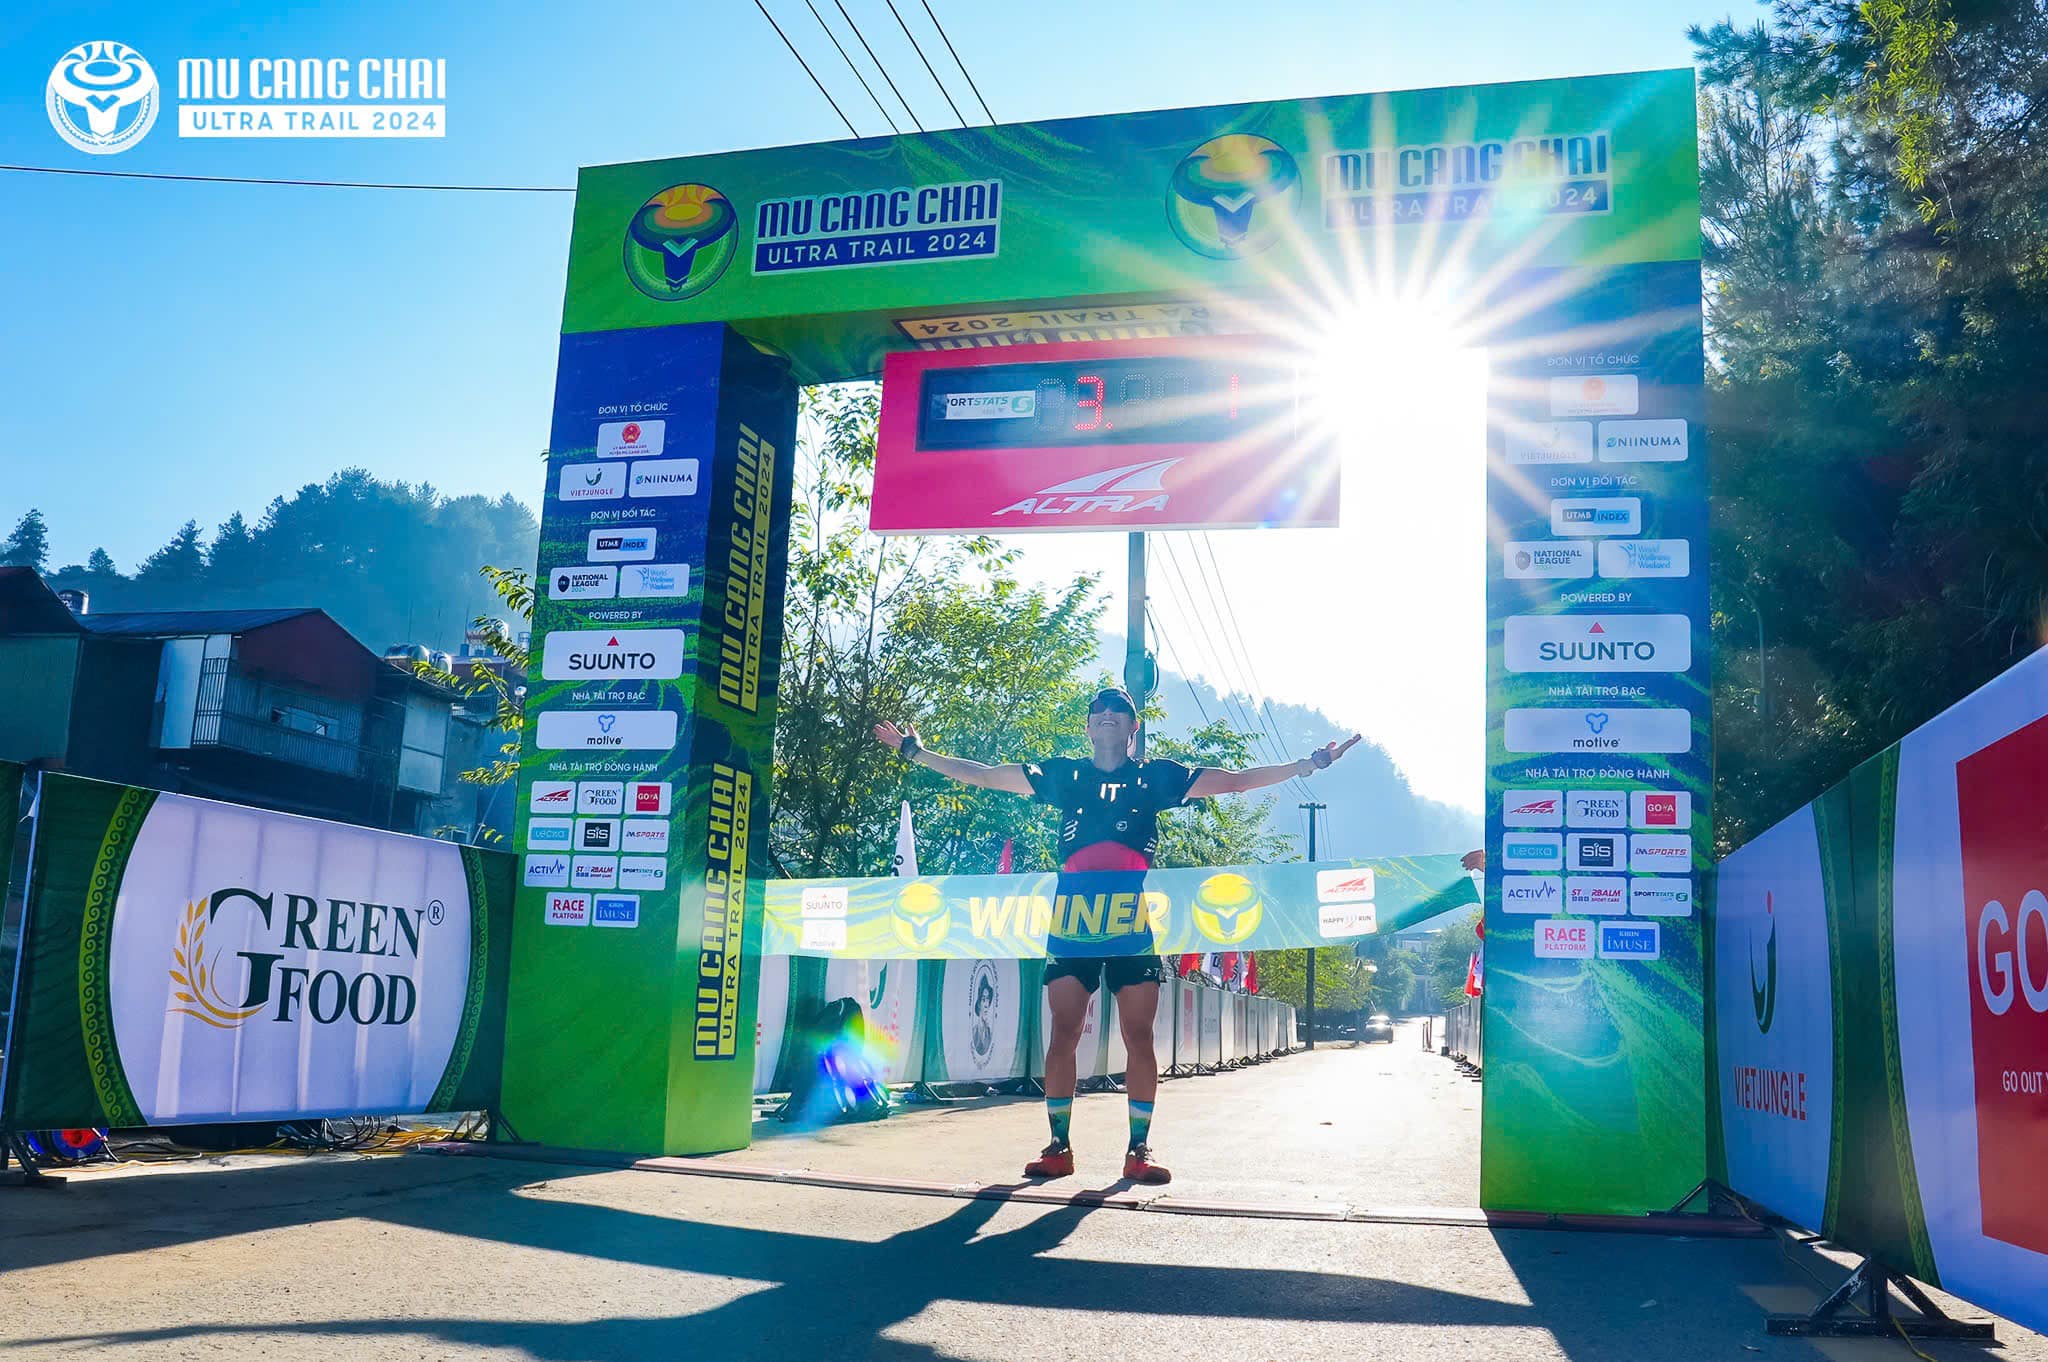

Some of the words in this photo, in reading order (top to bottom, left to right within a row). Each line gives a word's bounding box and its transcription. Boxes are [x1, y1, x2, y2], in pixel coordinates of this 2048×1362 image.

[1400, 142, 1503, 188] CANG
[1524, 184, 1599, 211] 024
[757, 199, 813, 239] MU
[819, 190, 910, 234] CANG
[916, 181, 998, 226] CHAI
[767, 244, 839, 266] ULTRA
[848, 238, 916, 259] TRAIL
[926, 231, 987, 253] 2024
[945, 394, 1009, 408] ORTSTATS
[1617, 436, 1681, 447] NIINUMA
[644, 474, 693, 484] NIINUMA
[734, 422, 759, 520] CHAI
[758, 446, 771, 516] 2024
[570, 487, 614, 497] VIETJUNGLE
[992, 495, 1172, 516] ALTRA
[1566, 510, 1592, 521] UTMB
[1598, 511, 1628, 522] INDEX
[1533, 549, 1582, 558] NATIONAL
[1533, 557, 1572, 565] LEAGUE
[751, 529, 767, 601] TRAIL
[725, 521, 752, 631] CANG
[1561, 593, 1616, 602] POWERED
[1618, 593, 1632, 602] BY
[588, 611, 630, 620] POWERED
[632, 611, 642, 619] BY
[568, 652, 656, 671] SUUNTO
[745, 614, 760, 696] ULTRA
[1539, 641, 1656, 661] SUUNTO
[719, 632, 743, 705] MU
[594, 797, 617, 806] FOOD
[708, 762, 735, 861] CHAI
[735, 781, 749, 850] 2024
[1590, 809, 1619, 818] FOOD
[1582, 842, 1611, 858] SiS
[553, 898, 584, 912] RACE
[728, 863, 744, 941] TRAIL
[806, 900, 843, 910] SUUNTO
[552, 911, 583, 920] PLATFORM
[701, 868, 729, 978] CANG
[968, 890, 1170, 939] WINNER
[1544, 927, 1587, 942] RACE
[1607, 935, 1650, 951] iMUSE
[1544, 943, 1587, 952] PLATFORM
[273, 966, 417, 1026] FOOD
[722, 953, 738, 1040] ULTRA
[695, 986, 720, 1057] MU
[2002, 1071, 2018, 1092] GO
[2020, 1071, 2043, 1094] OUT
[1734, 1066, 1806, 1121] VIETJUNGLE
